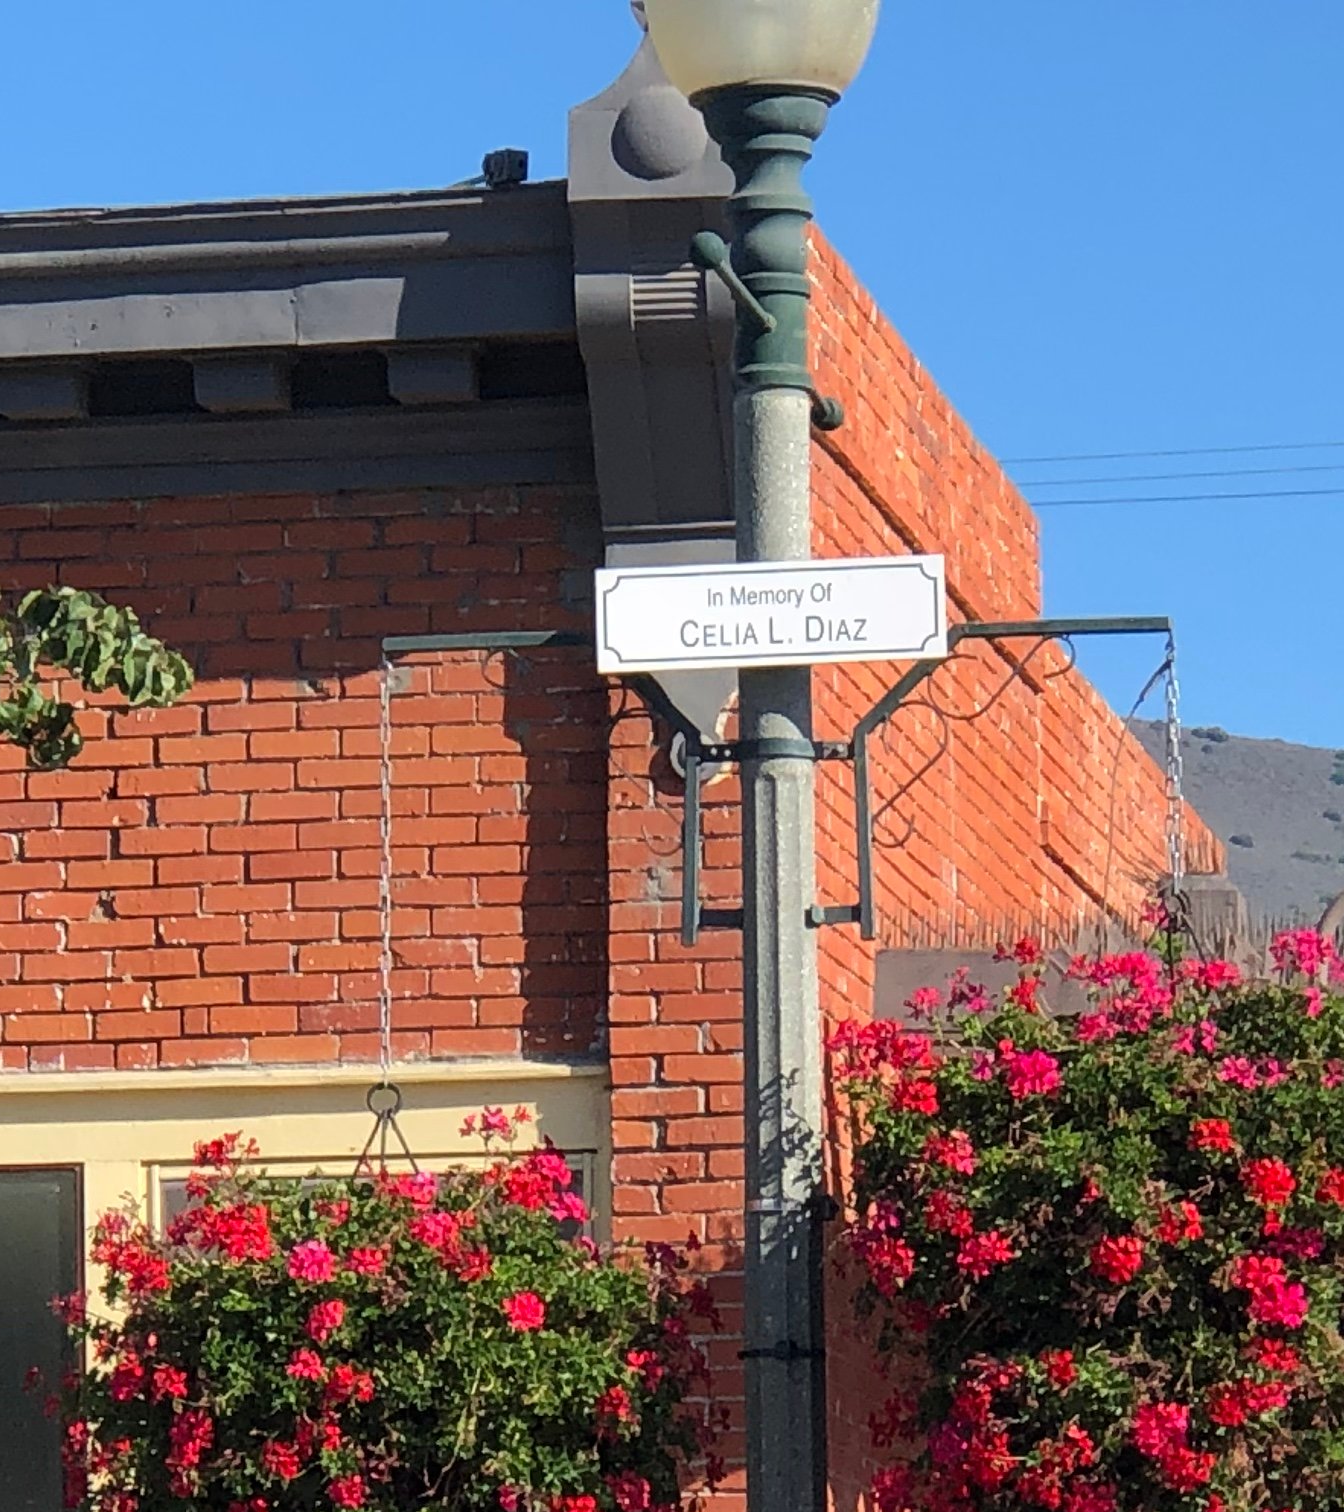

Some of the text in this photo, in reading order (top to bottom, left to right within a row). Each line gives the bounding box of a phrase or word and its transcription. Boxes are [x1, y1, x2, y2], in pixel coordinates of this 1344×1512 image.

[707, 582, 833, 608] In Memory Of
[680, 614, 867, 648] CELIA L. DIAZ
